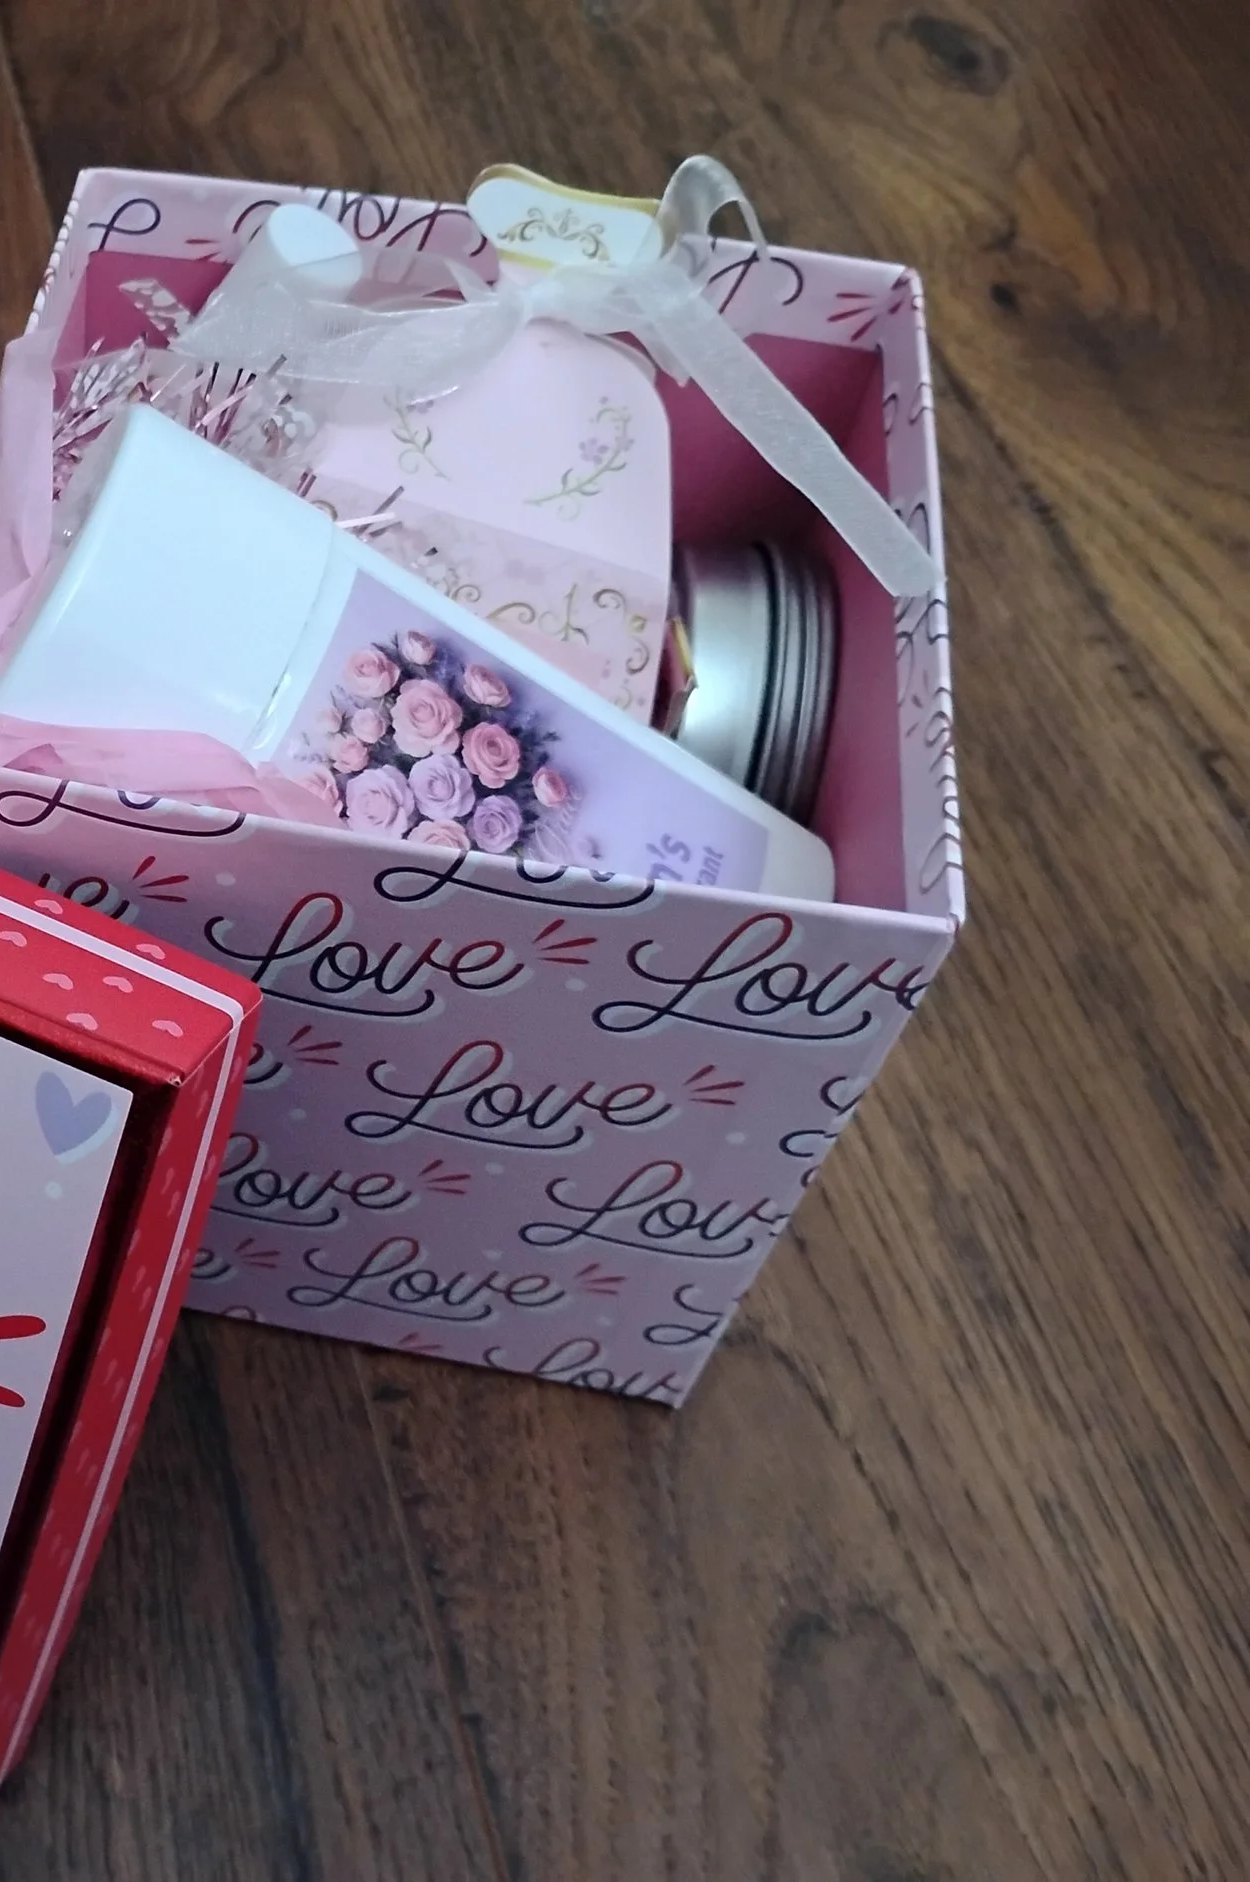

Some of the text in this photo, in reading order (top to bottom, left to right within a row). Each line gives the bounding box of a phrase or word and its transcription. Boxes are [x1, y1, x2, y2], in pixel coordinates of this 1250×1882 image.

[204, 892, 524, 1017] Love
[345, 1041, 673, 1149] Love
[518, 1160, 790, 1258] Lov
[286, 1236, 565, 1321] Love
